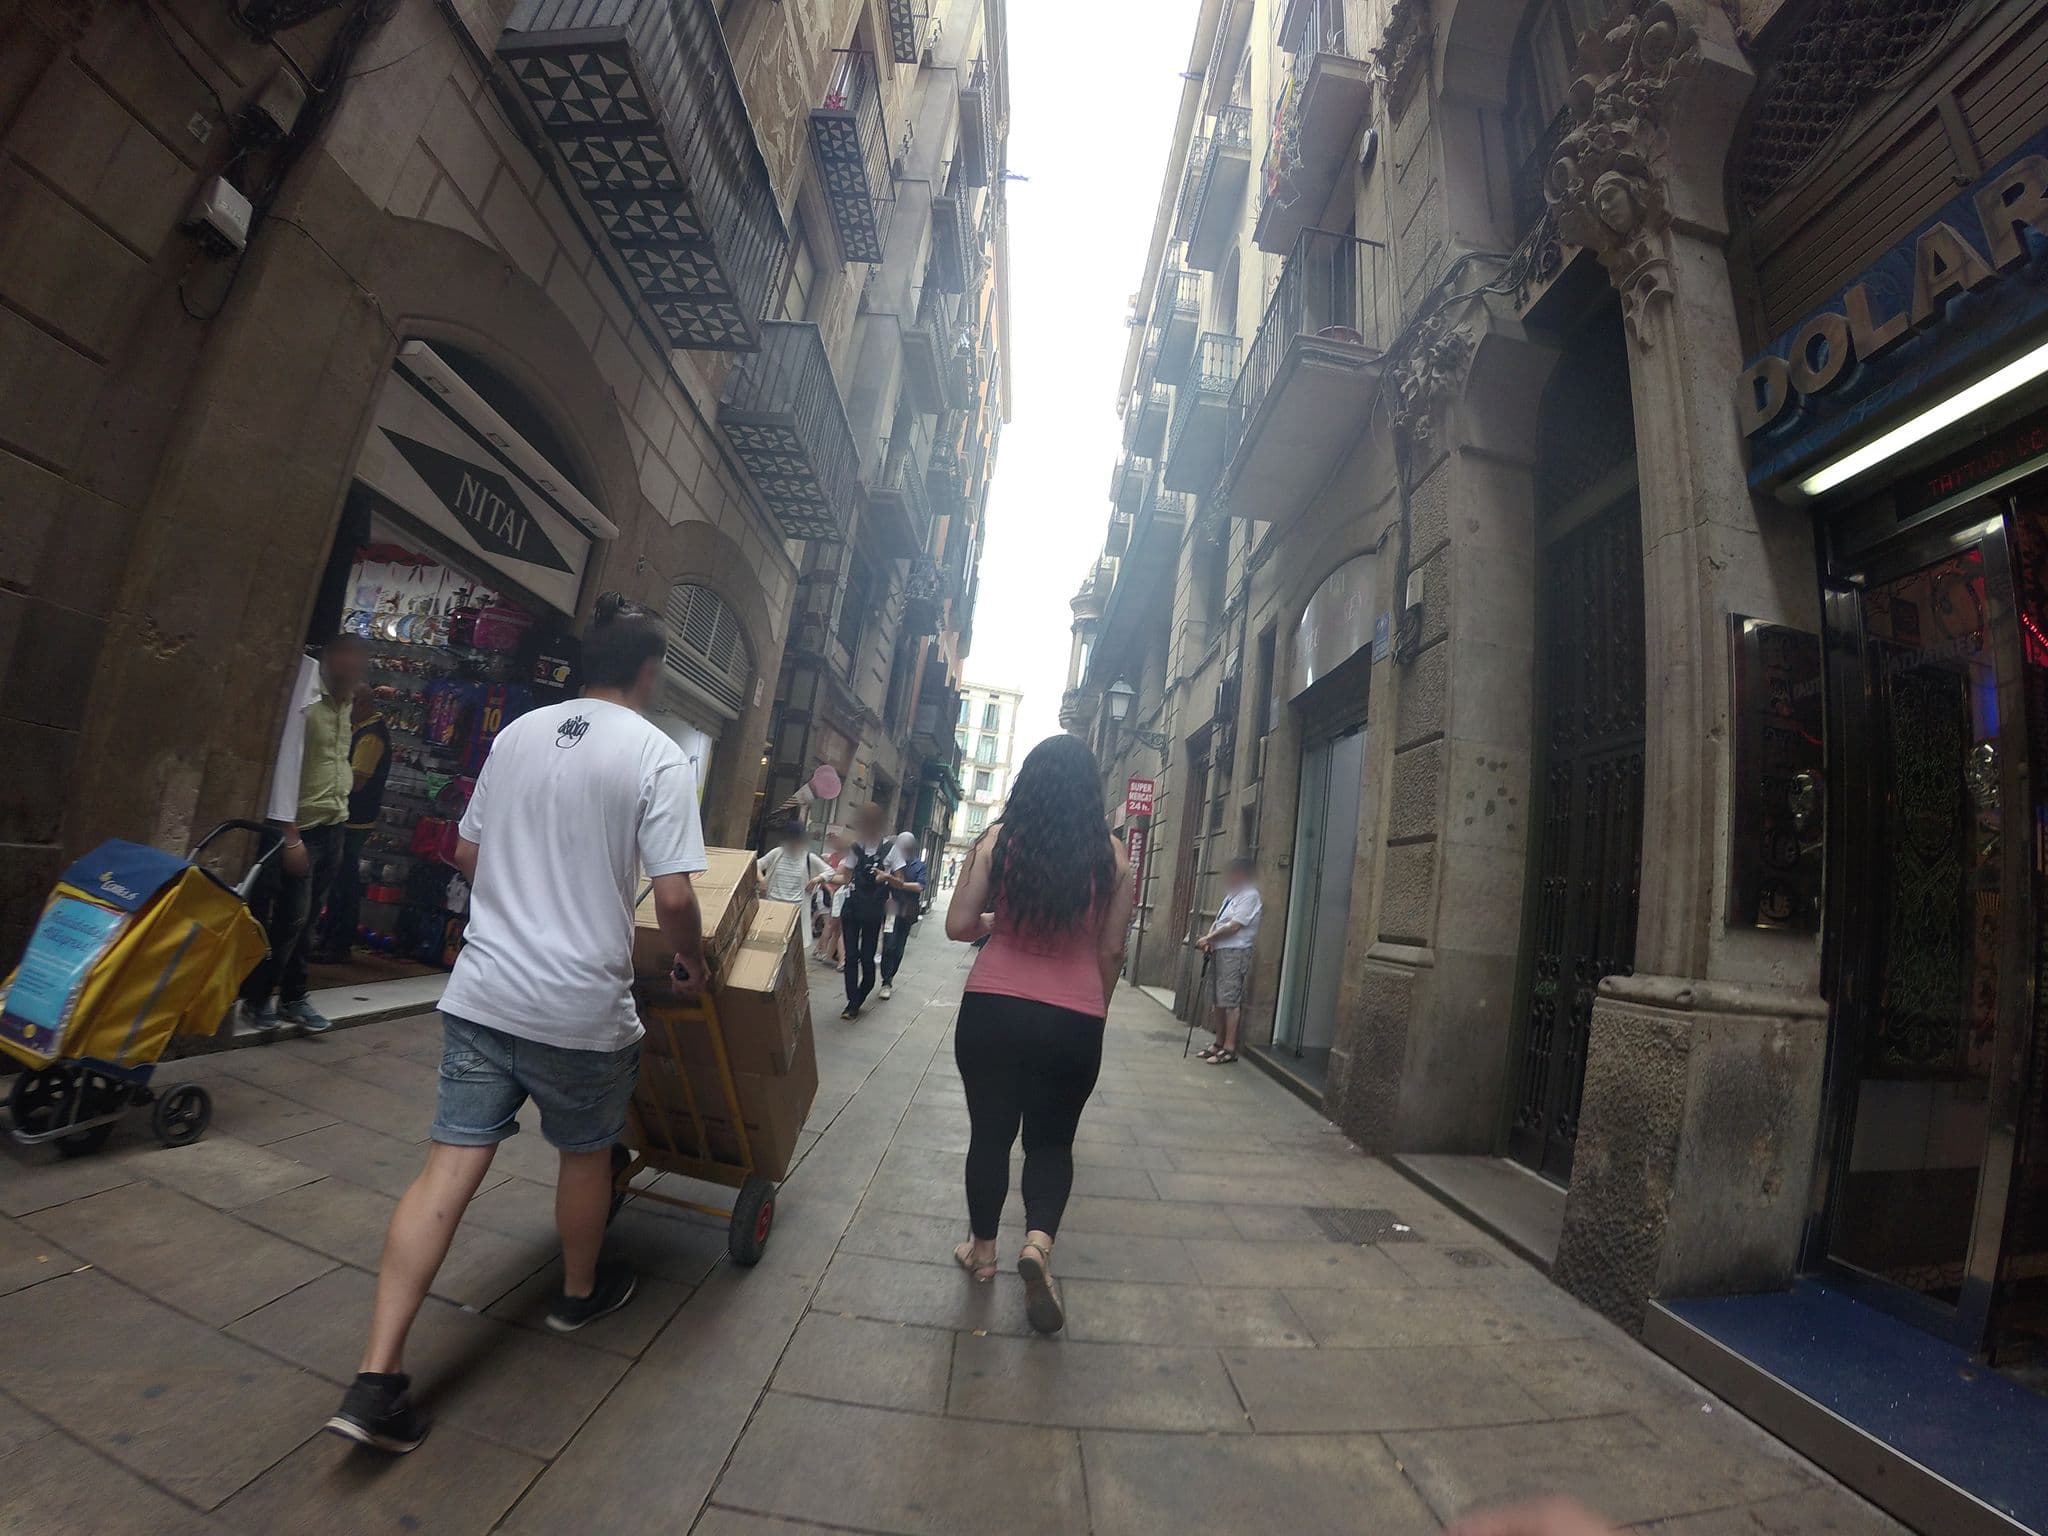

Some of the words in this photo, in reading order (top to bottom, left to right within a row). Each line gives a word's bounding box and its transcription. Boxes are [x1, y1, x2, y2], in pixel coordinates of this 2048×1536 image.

[1734, 154, 2048, 439] DOLAR
[454, 471, 528, 551] NITAI
[483, 706, 502, 732] 10
[1129, 791, 1152, 803] MERCAT
[1130, 782, 1152, 793] SUPER
[1129, 801, 1141, 810] 24
